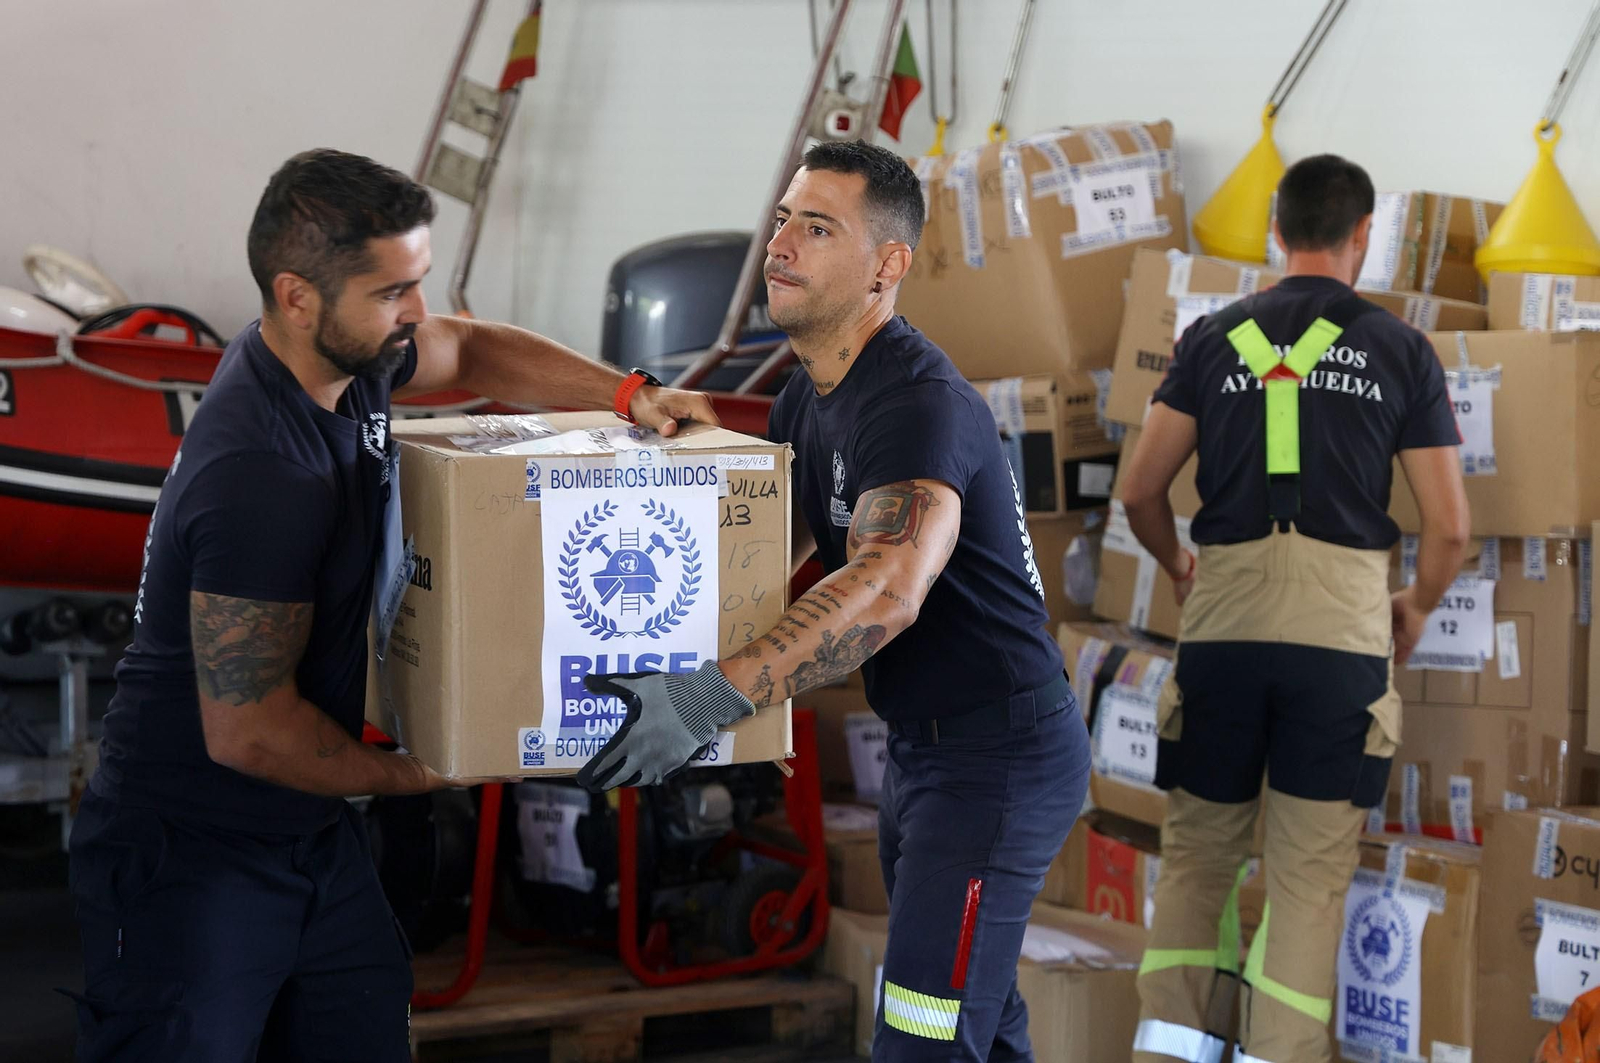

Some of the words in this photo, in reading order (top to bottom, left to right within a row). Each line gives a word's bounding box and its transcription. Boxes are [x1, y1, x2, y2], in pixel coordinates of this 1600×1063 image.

[1091, 184, 1135, 203] BULTO
[550, 467, 648, 489] BOMBEROS
[652, 465, 718, 487] UNIDOS
[1439, 619, 1459, 636] 12
[1118, 715, 1158, 735] BULT
[1558, 938, 1600, 961] BULT
[1580, 970, 1590, 987] 7
[1346, 985, 1410, 1021] BUSE
